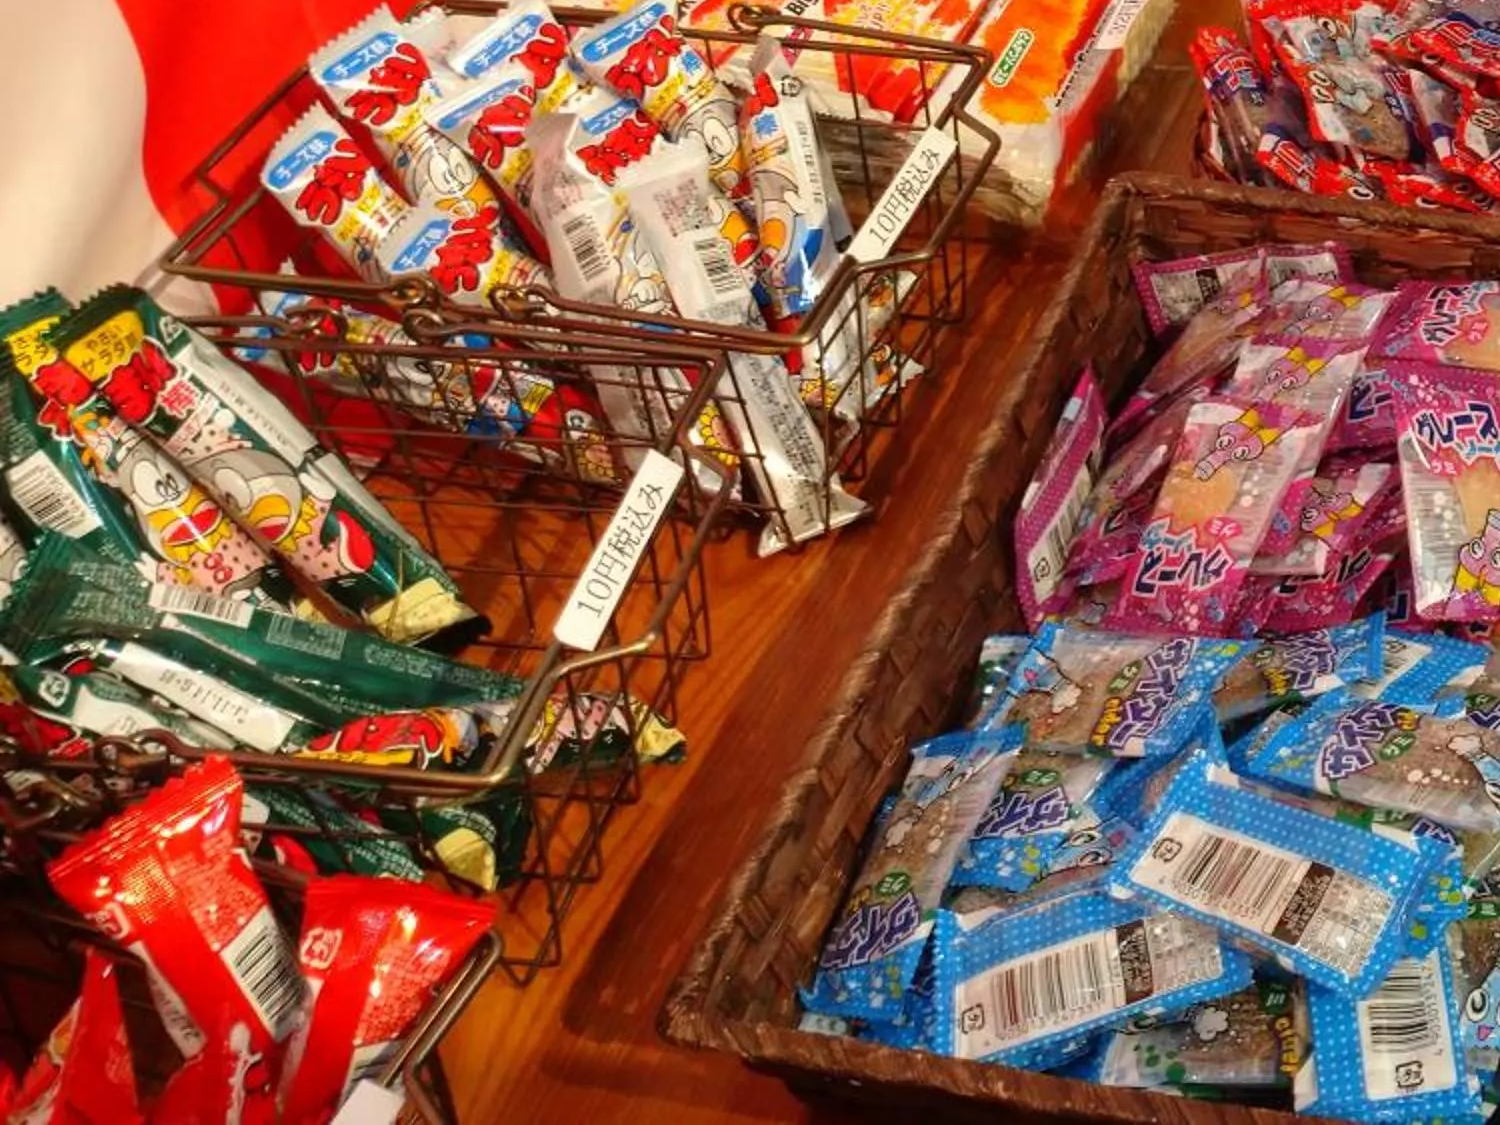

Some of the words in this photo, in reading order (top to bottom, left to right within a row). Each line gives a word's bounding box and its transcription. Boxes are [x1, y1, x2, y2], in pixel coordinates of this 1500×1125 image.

[868, 148, 941, 248] 10円税込み
[576, 482, 665, 619] 10円税込み
[1133, 542, 1233, 596] グレープ
